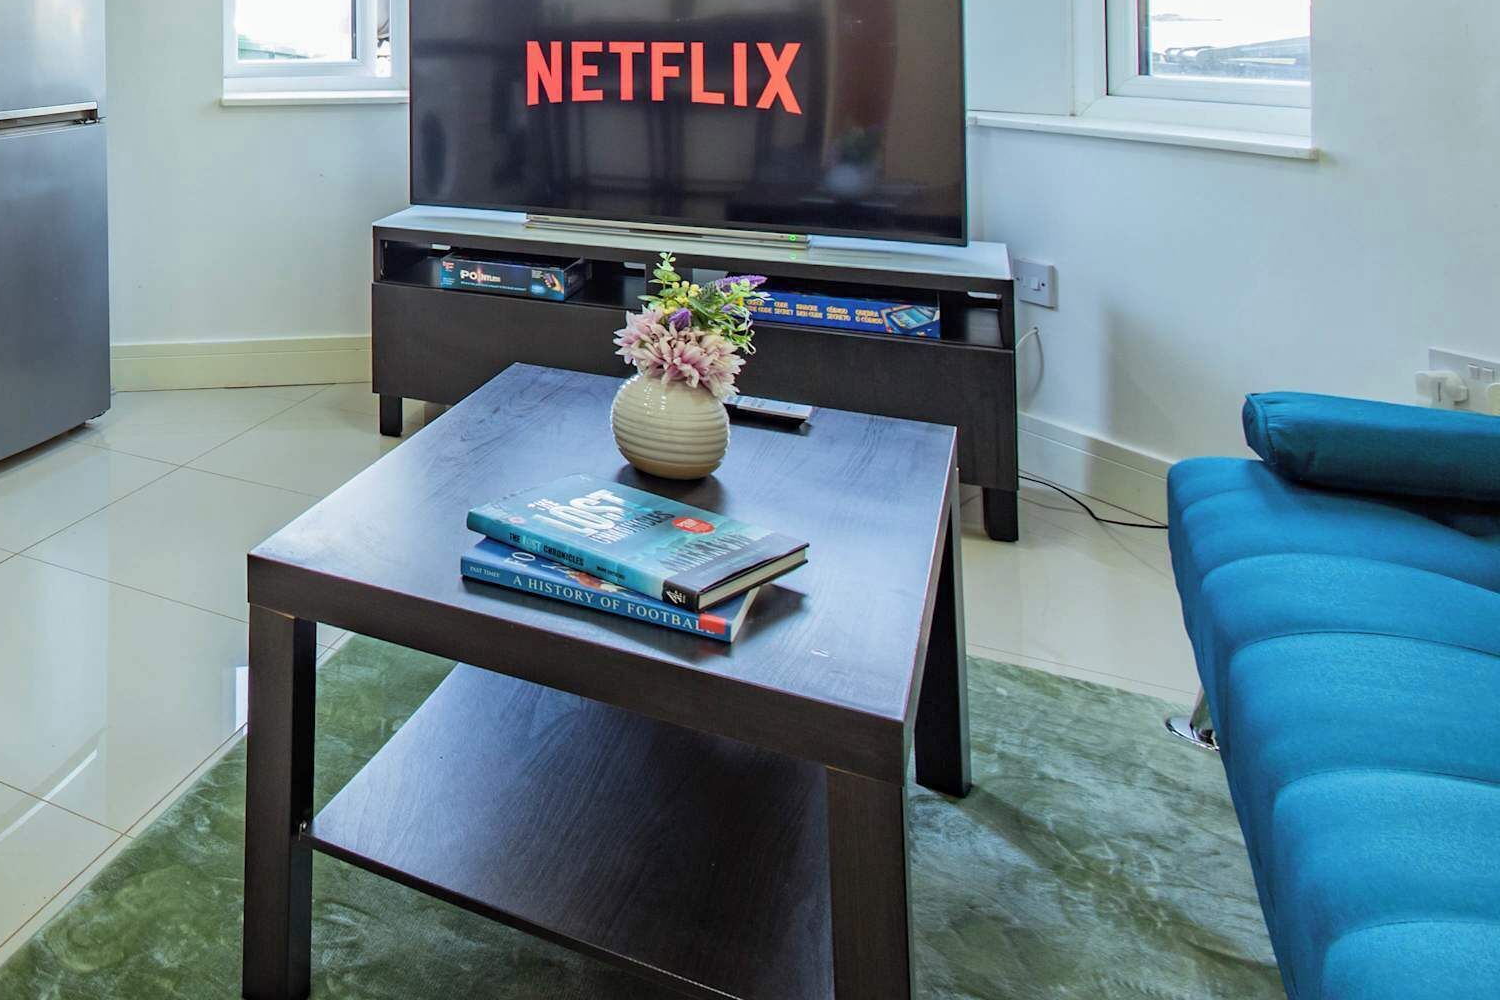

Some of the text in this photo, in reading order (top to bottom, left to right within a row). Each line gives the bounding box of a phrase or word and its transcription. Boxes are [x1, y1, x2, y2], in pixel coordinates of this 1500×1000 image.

[526, 40, 802, 114] NETFLIX
[532, 489, 645, 538] LOST
[509, 532, 521, 543] THE
[522, 535, 542, 551] LOST
[543, 544, 584, 566] CHRONICLES
[513, 575, 522, 586] A
[528, 578, 594, 603] HISTORY
[600, 597, 619, 610] OF
